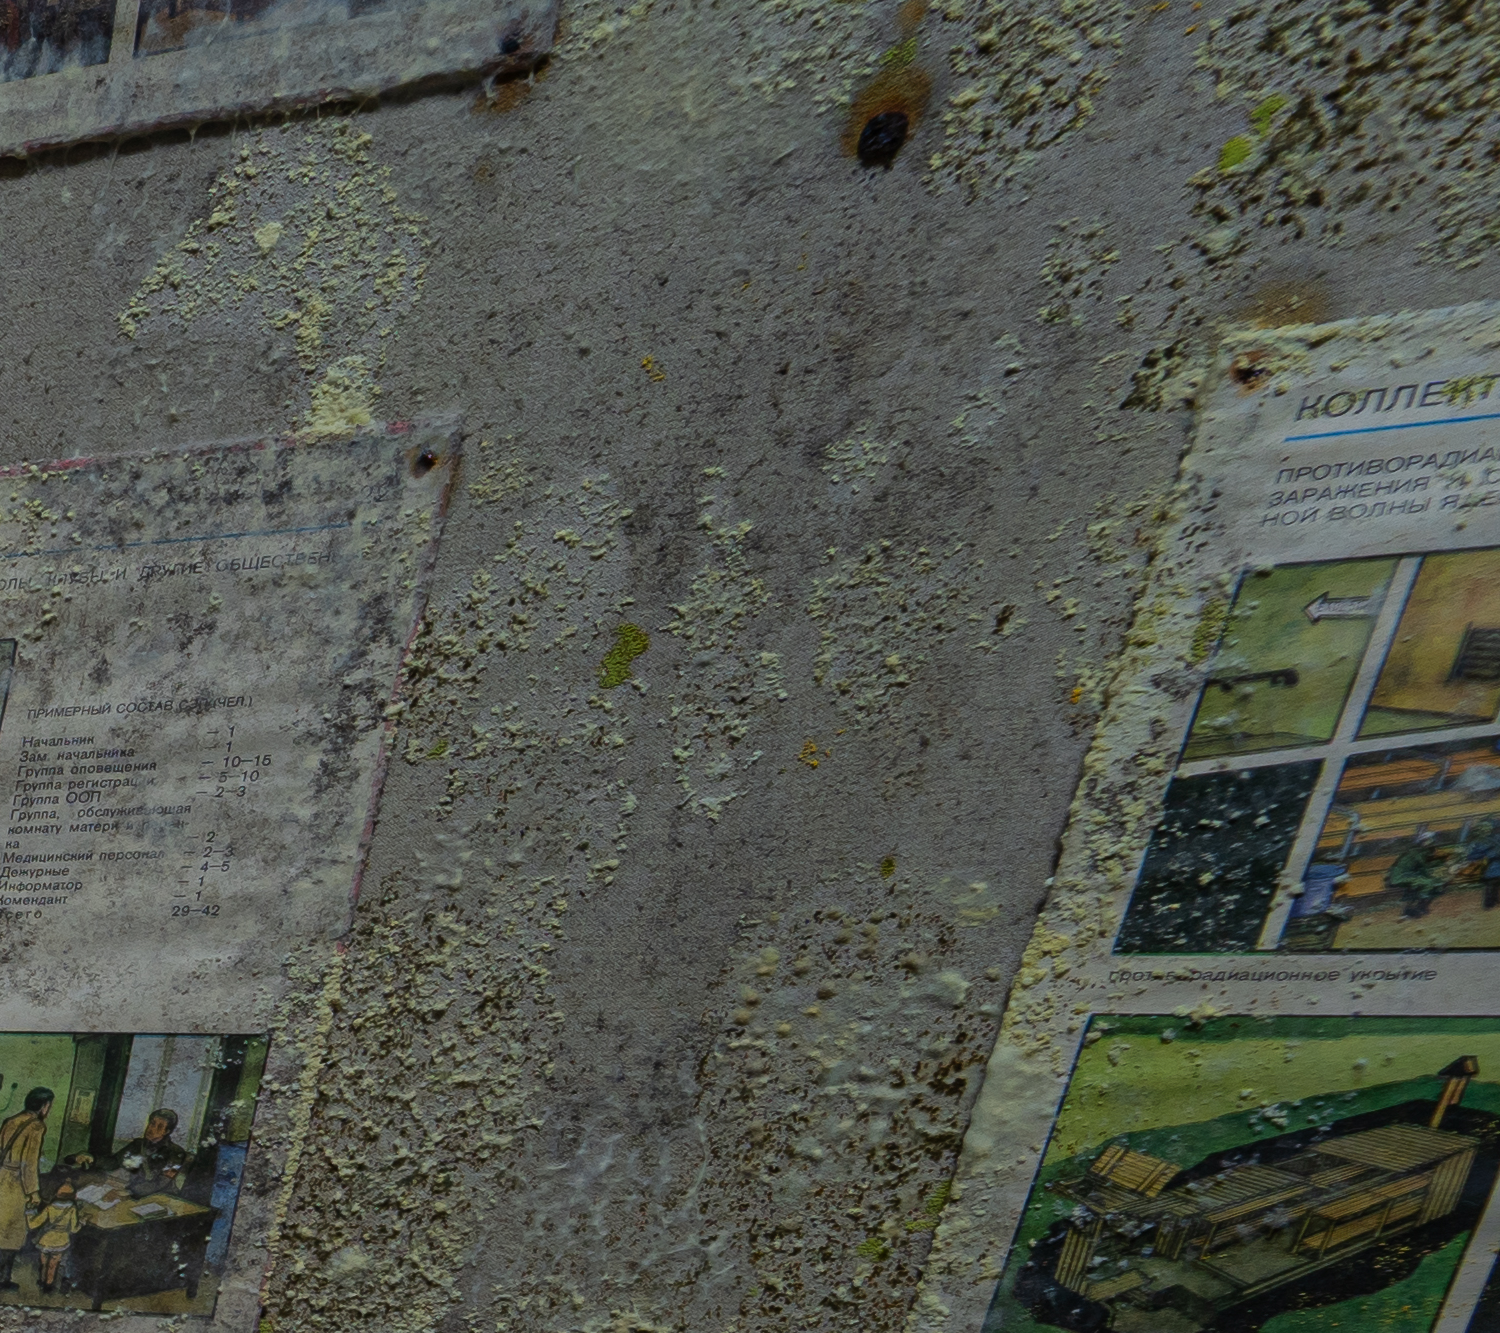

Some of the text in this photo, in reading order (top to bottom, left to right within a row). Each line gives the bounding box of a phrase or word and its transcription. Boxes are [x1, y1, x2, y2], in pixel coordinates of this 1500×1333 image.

[1269, 476, 1431, 508] ЗАРАЖЕНИЯ
[1261, 497, 1431, 528] НОЙ ВОЛНЫ
[27, 699, 173, 719] ПРИМЕРНЫЙ СОСТАВ
[22, 735, 95, 749] Начальник
[57, 748, 135, 761] начальника
[17, 761, 157, 779] Группа оповещения
[15, 780, 63, 793] Группа
[13, 791, 101, 808] Группа ООП
[7, 824, 62, 837] комнату
[5, 840, 20, 849] ка
[3, 852, 94, 864] Медицинский
[0, 866, 70, 879] Дежурные
